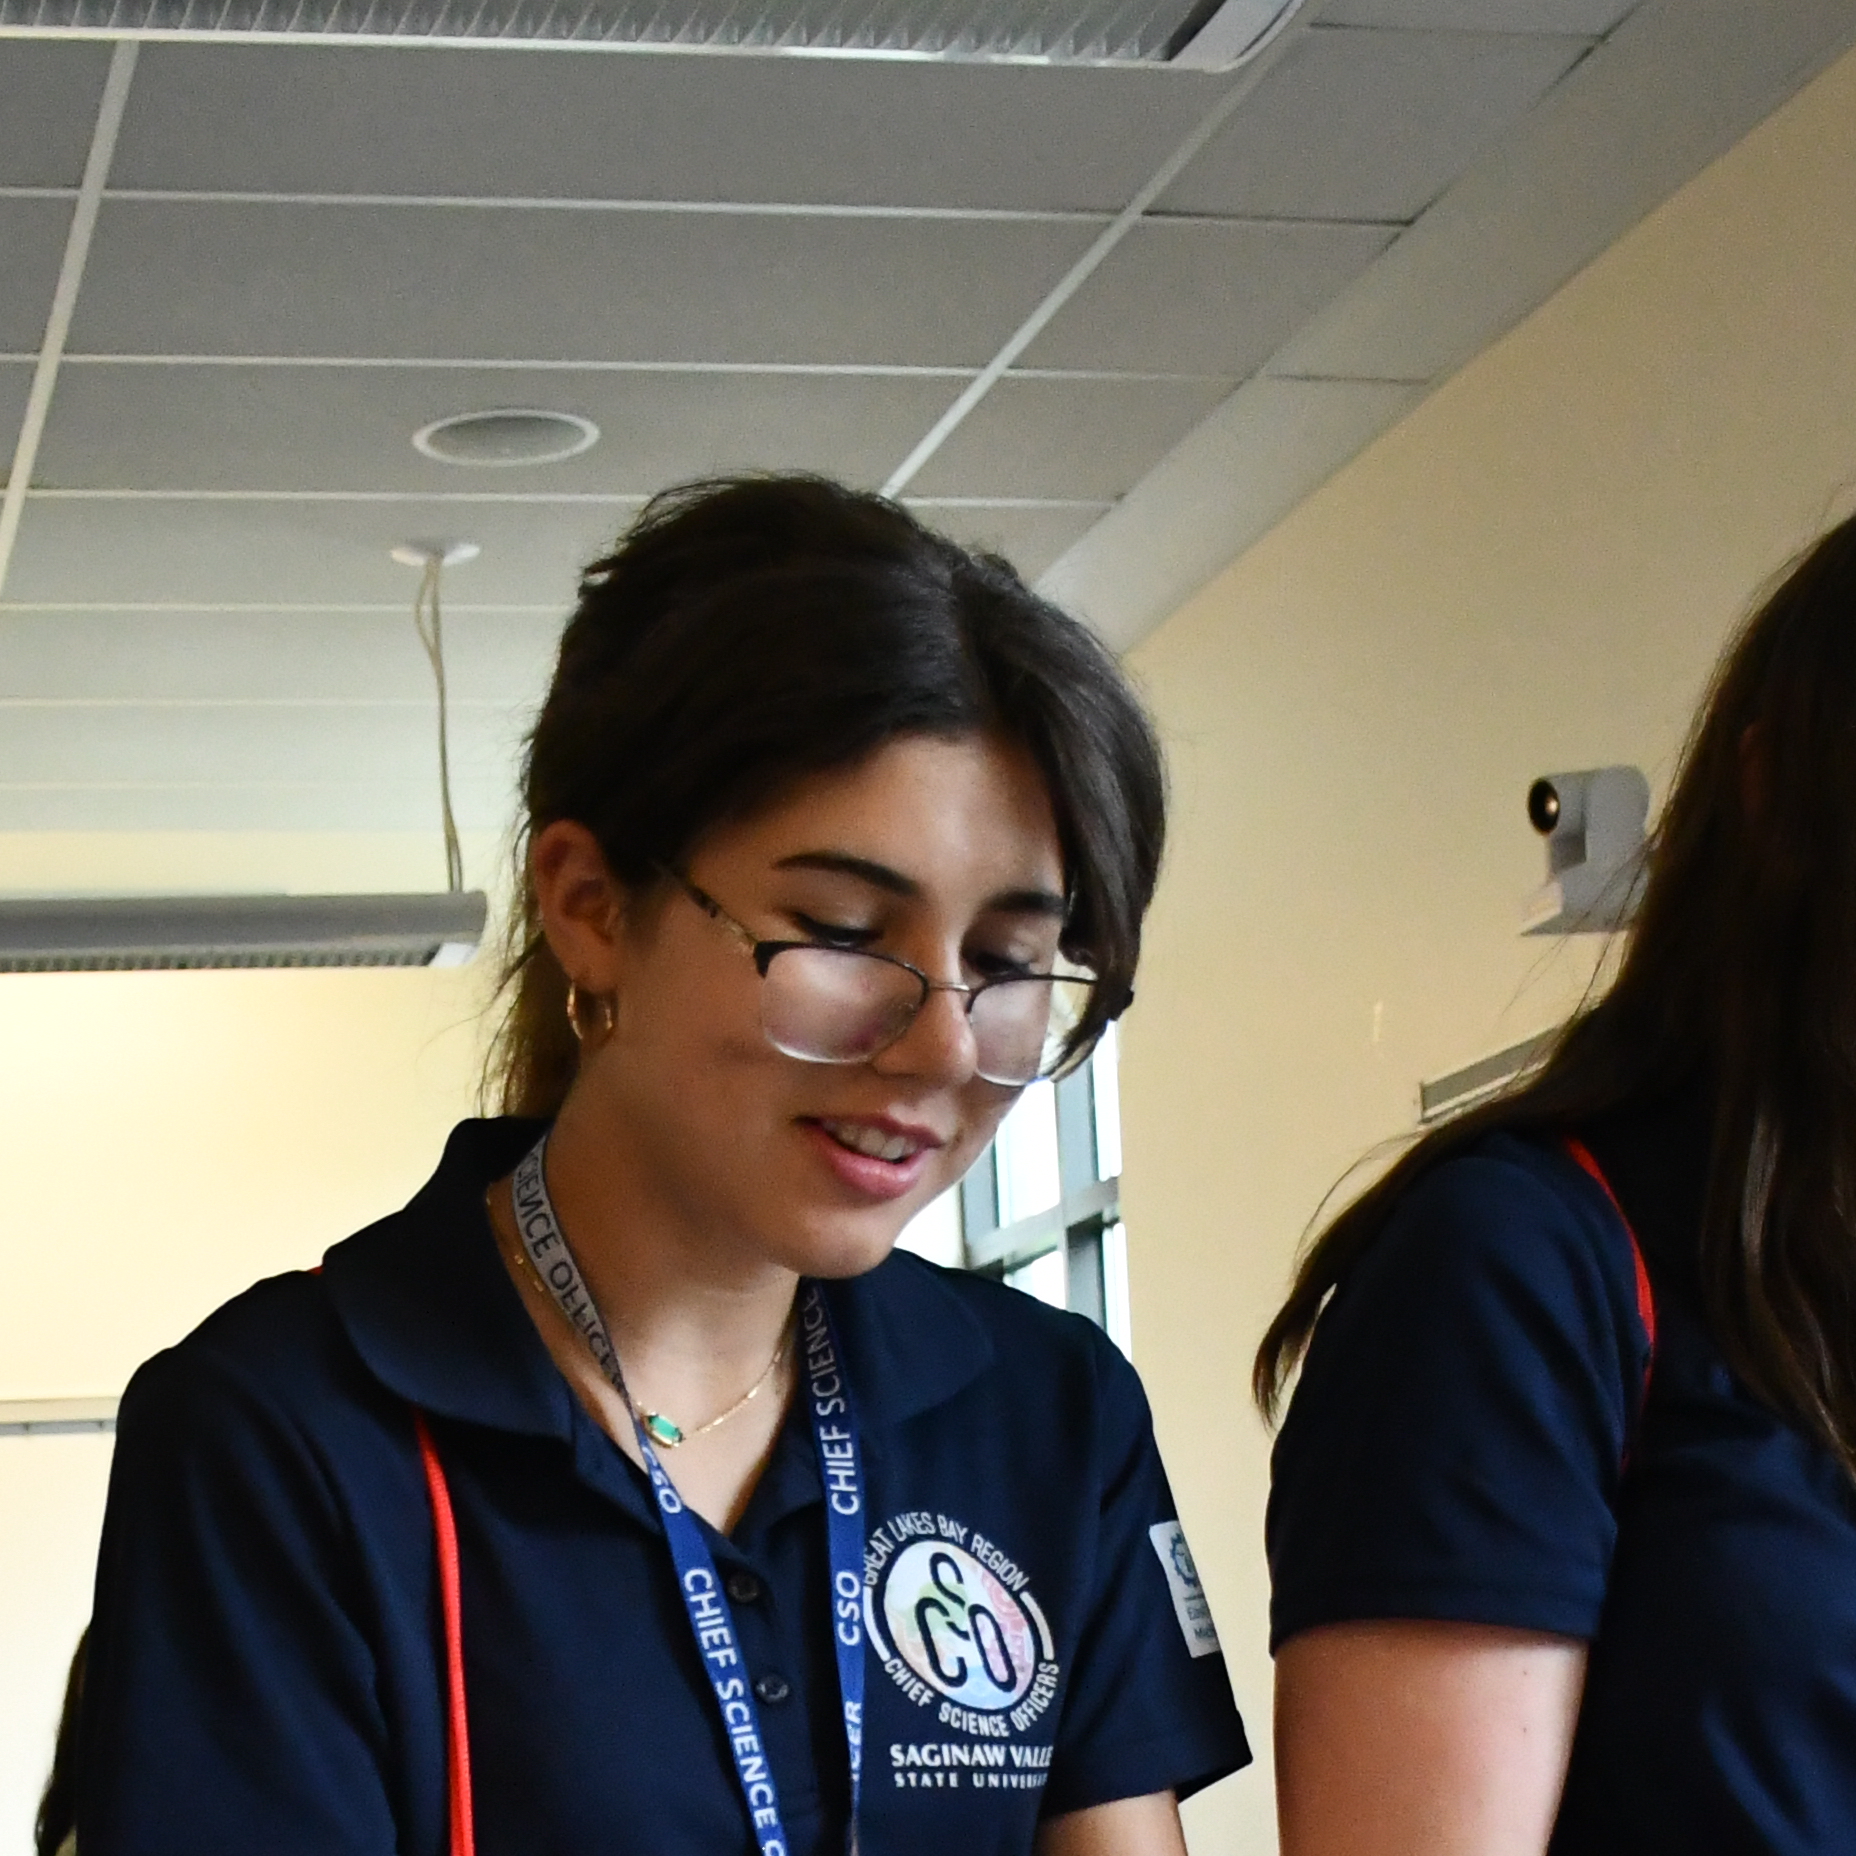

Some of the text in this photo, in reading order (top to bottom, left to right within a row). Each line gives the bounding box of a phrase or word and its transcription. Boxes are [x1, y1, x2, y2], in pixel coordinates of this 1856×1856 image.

[819, 1426, 861, 1515] CHIEF
[886, 1511, 937, 1542] LAKES
[937, 1514, 969, 1545] BAY
[970, 1533, 1030, 1592] REGION
[640, 1445, 683, 1515] CSO
[684, 1567, 739, 1668] CHIEF
[716, 1676, 778, 1829] SCIENCE
[835, 1571, 861, 1647] CSO
[884, 1657, 1060, 1738] CHIEF SCIENCE OFFICERS
[890, 1743, 1054, 1768] SAGINAW VALLE
[894, 1772, 959, 1789] STATE
